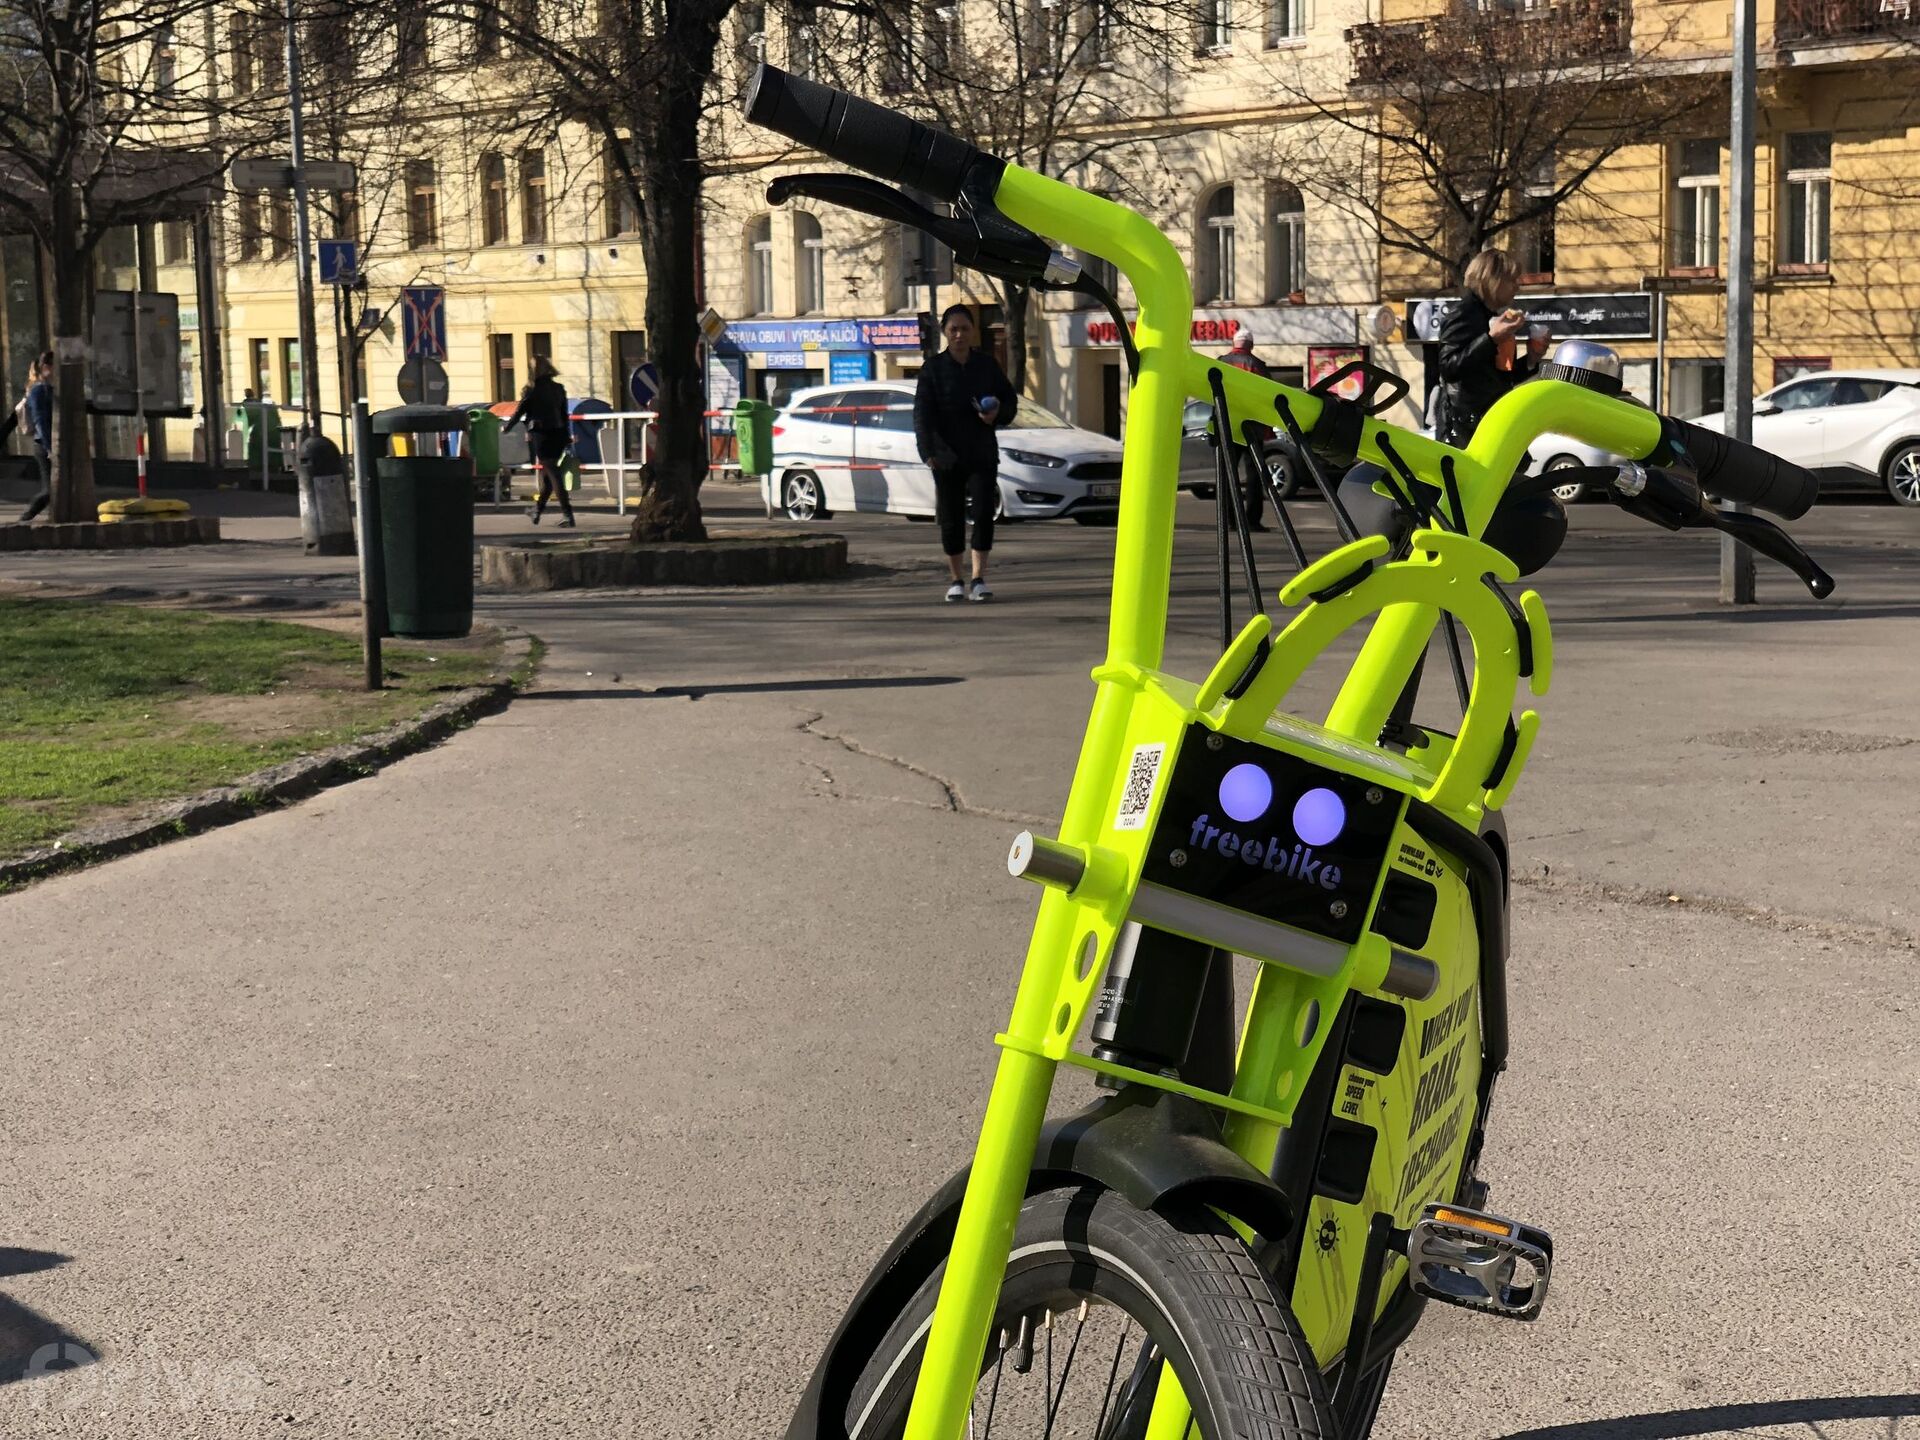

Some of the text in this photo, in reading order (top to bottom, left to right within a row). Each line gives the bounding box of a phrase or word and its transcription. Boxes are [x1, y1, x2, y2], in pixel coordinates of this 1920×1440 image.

[759, 330, 786, 344] OBUVI
[791, 327, 830, 343] VÝROBA
[831, 326, 859, 343] KLÍČŮ
[767, 354, 804, 367] EXPRES
[1189, 814, 1342, 890] freebike
[1420, 999, 1457, 1059] WHEN
[1345, 1084, 1365, 1100] SPEED
[1407, 1033, 1467, 1141] BRAKE
[1341, 1100, 1359, 1116] LEVEL
